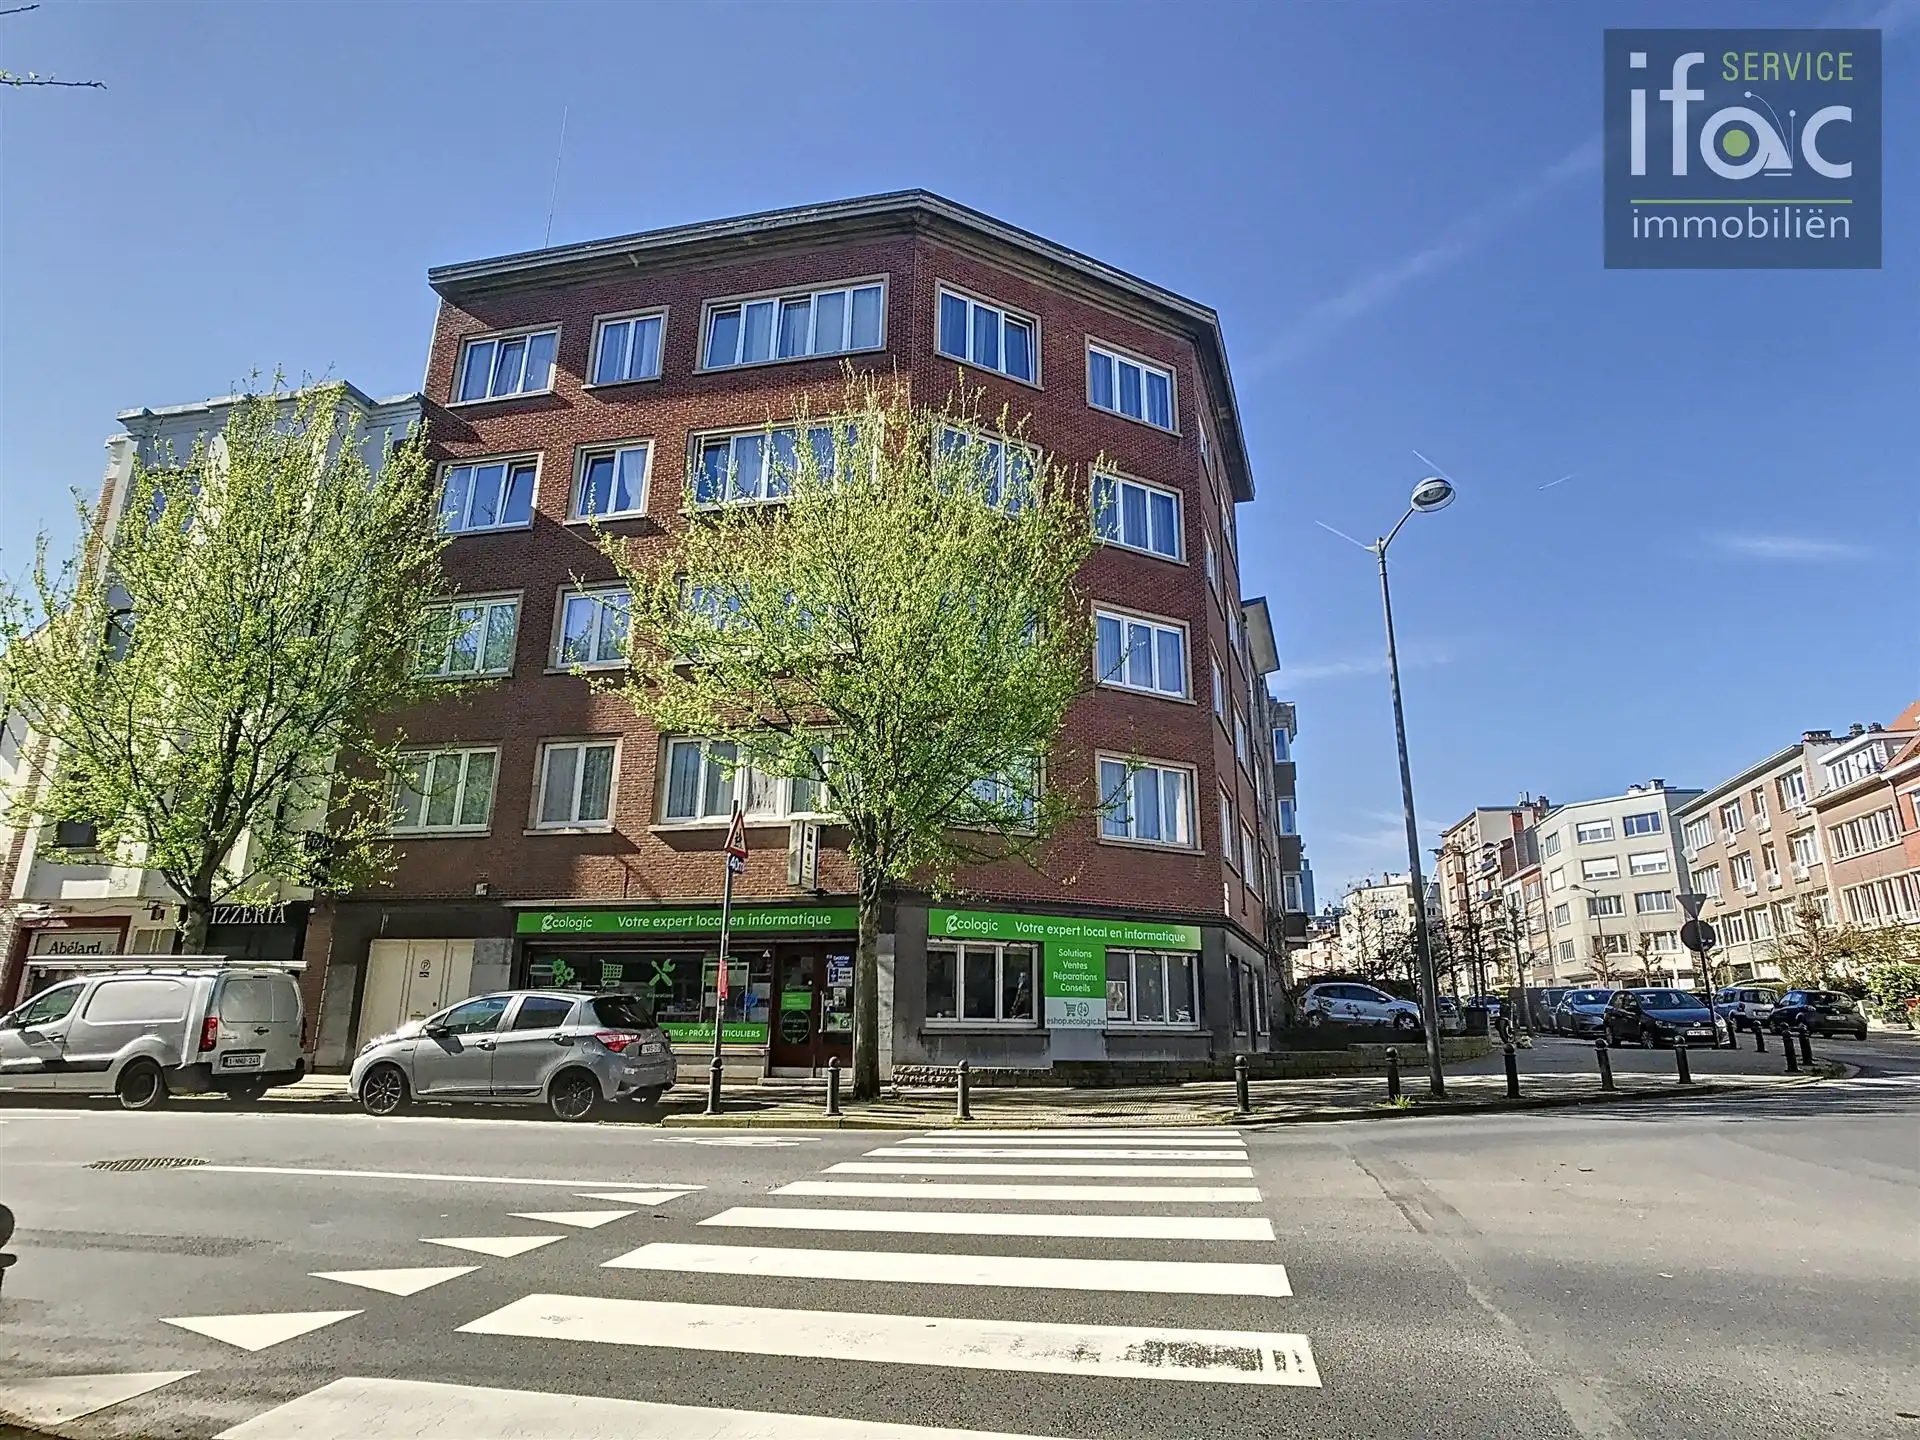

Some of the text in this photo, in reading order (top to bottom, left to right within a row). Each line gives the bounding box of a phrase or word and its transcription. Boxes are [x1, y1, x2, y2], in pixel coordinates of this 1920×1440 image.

[209, 904, 286, 924] IZZERIA
[618, 915, 649, 928] Votre
[653, 915, 692, 929] expert
[696, 914, 722, 926] loca
[729, 916, 744, 926] en
[748, 912, 832, 928] informatique
[1015, 920, 1044, 934] Votre
[1047, 924, 1080, 938] expert
[1083, 925, 1107, 938] local
[1110, 929, 1121, 939] en
[1125, 928, 1186, 944] informatique
[1058, 948, 1092, 958] Solutions
[1063, 960, 1088, 970] Ventes
[1053, 971, 1098, 982] Réparations
[1060, 983, 1091, 993] Conseils
[1046, 1017, 1106, 1027] eshop.ecologic.be
[688, 1029, 703, 1037] PRO
[704, 1029, 710, 1037] &
